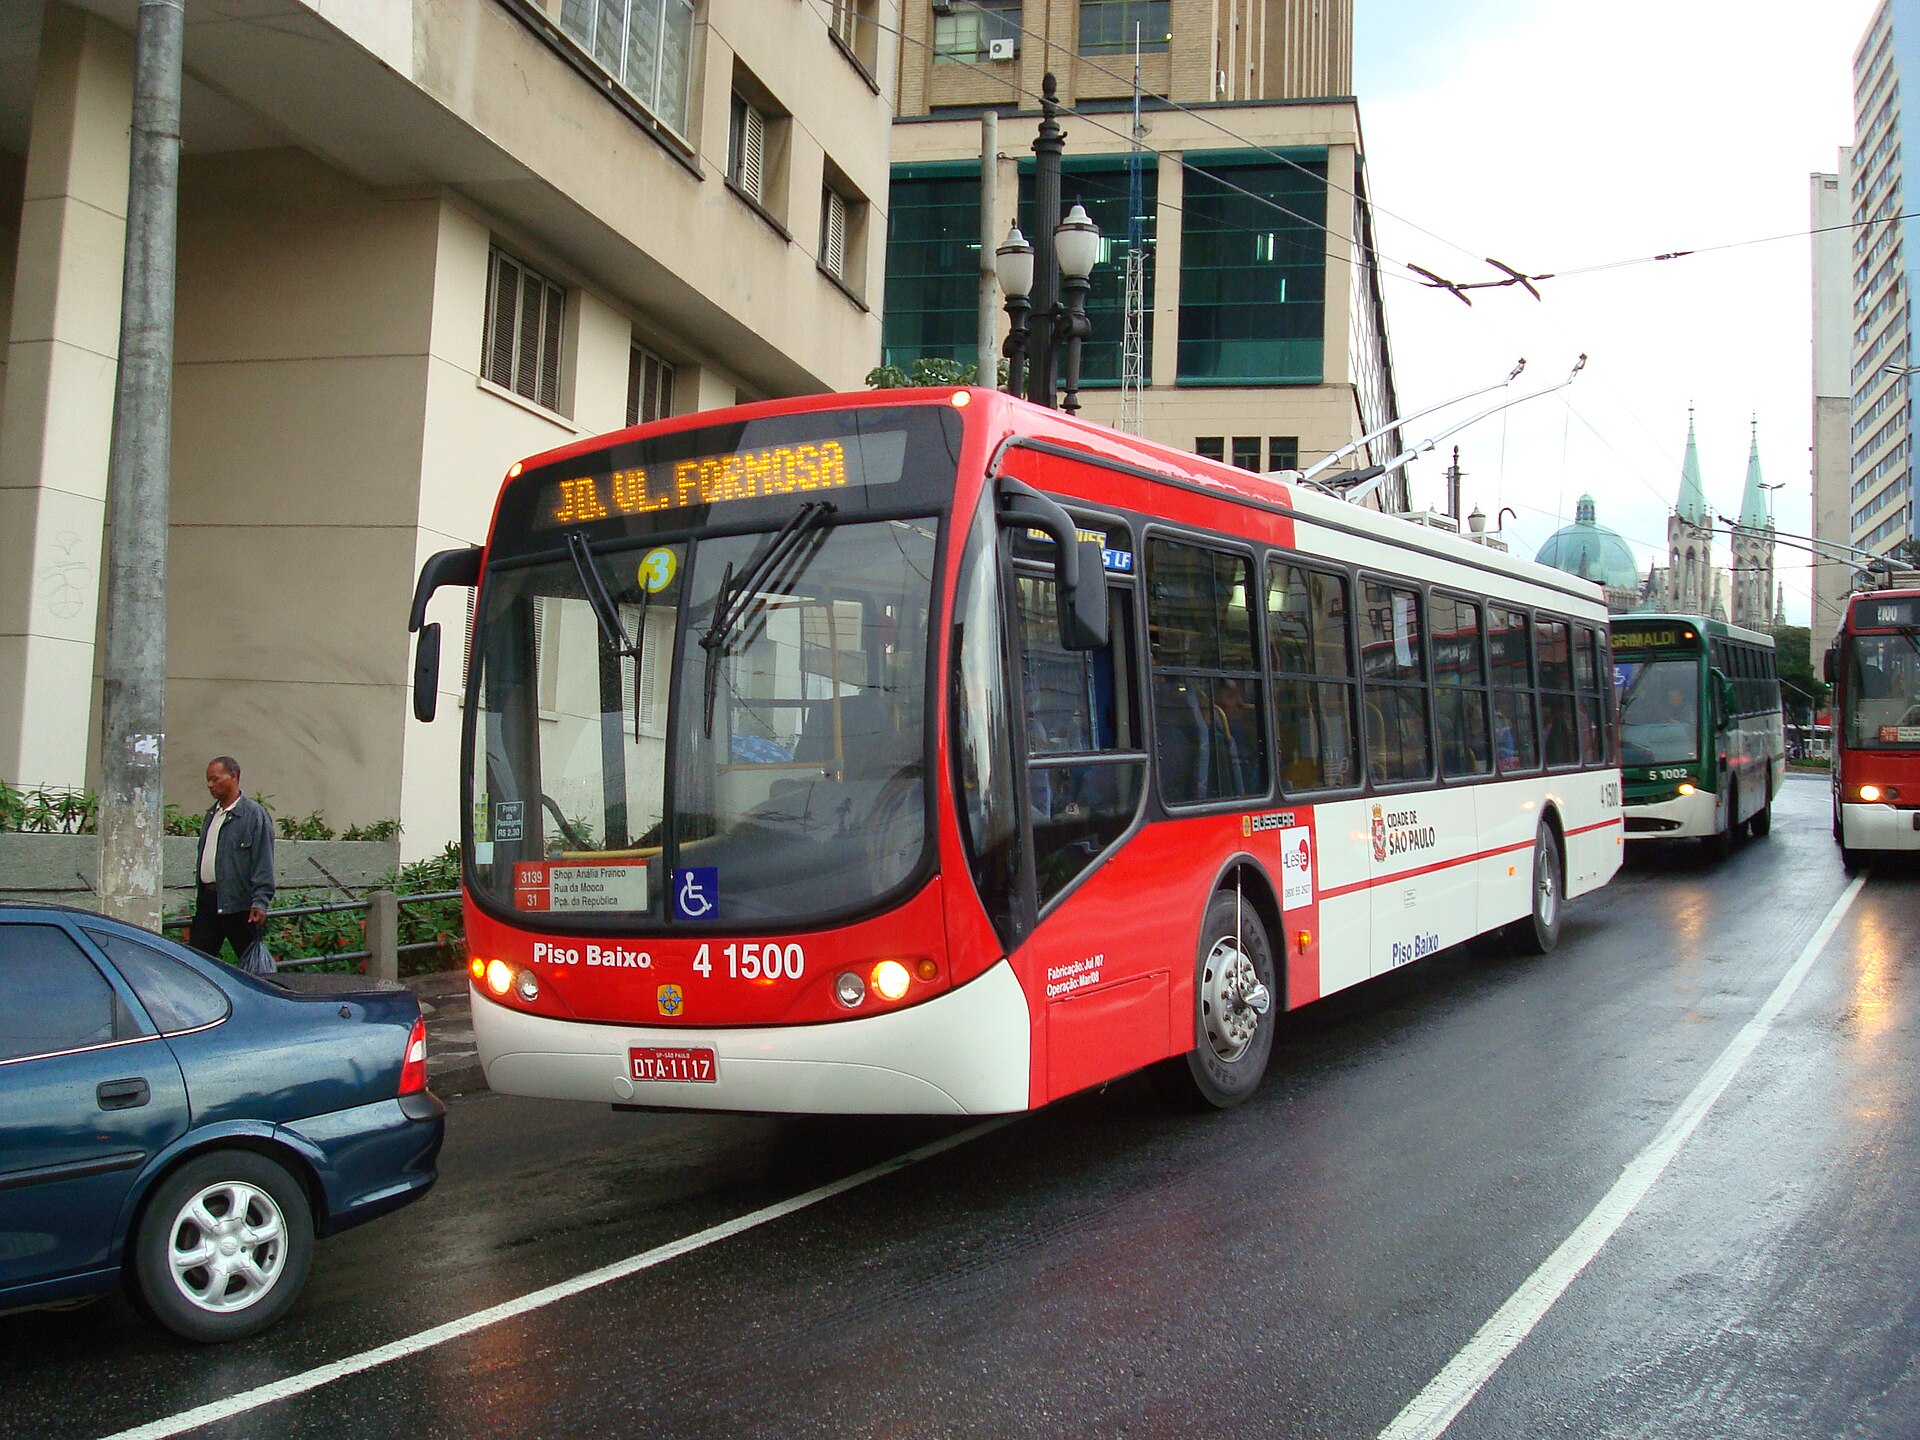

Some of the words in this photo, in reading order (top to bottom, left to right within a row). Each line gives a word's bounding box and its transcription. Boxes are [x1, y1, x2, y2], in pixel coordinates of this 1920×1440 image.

[677, 440, 846, 506] FORMOSA
[1115, 552, 1131, 568] LF
[647, 552, 669, 589] 3
[1648, 770, 1658, 780] S
[1660, 768, 1688, 780] 1002
[1387, 811, 1409, 829] CIDADE
[1409, 810, 1418, 825] DE
[1389, 829, 1408, 855] SÃO
[1408, 826, 1436, 851] PAULO
[521, 871, 543, 884] 3139
[553, 870, 574, 881] Shop.
[576, 868, 599, 879] Anália
[600, 868, 626, 878] Franco
[554, 883, 568, 893] Rua
[569, 883, 579, 892] da
[580, 882, 605, 892] Mooca
[527, 893, 538, 907] 31
[570, 896, 580, 906] da
[582, 896, 618, 908] República
[533, 942, 579, 964] Piso
[586, 945, 651, 968] Baixo
[1392, 941, 1412, 967] Piso
[1414, 931, 1439, 957] Baixo
[692, 943, 712, 978] 4
[723, 943, 805, 979] 1500
